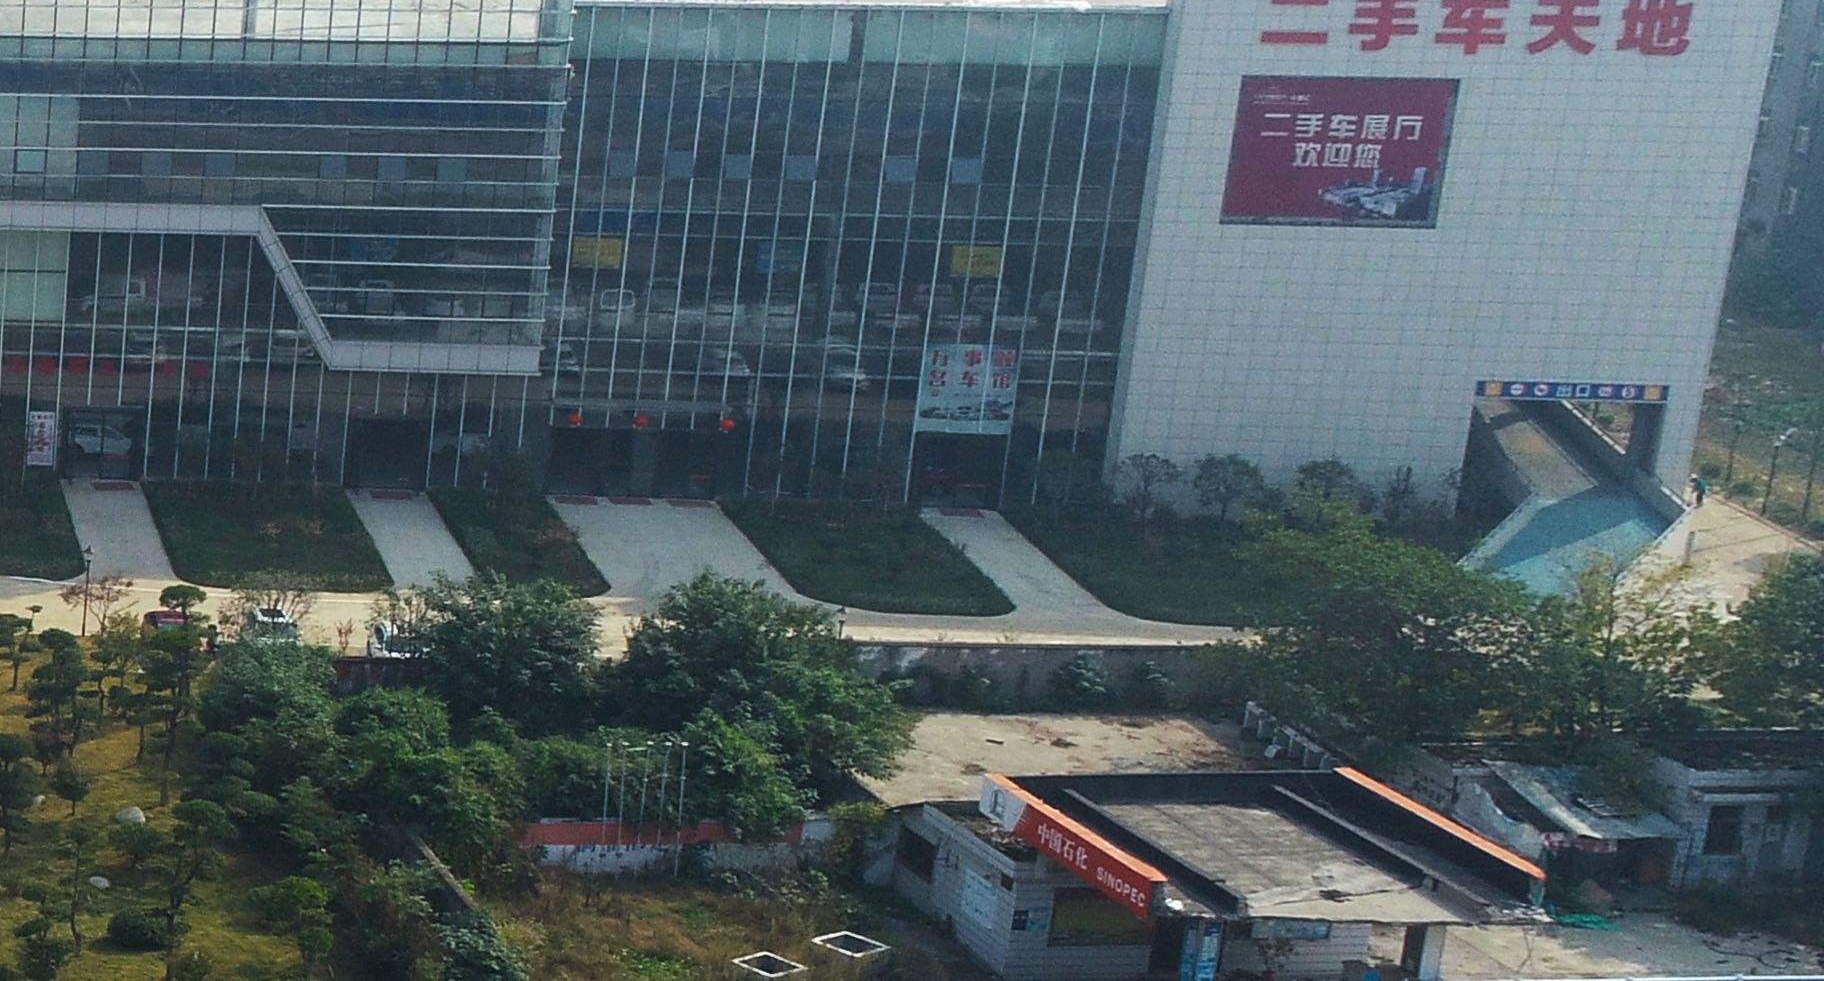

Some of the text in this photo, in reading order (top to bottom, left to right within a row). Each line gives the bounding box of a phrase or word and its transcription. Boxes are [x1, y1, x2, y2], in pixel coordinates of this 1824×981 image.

[1260, 113, 1424, 140] 二手车展厅
[1293, 142, 1382, 169] 欢迎您
[1038, 822, 1088, 870] 中国石化
[1096, 866, 1146, 907] SINOPEC
